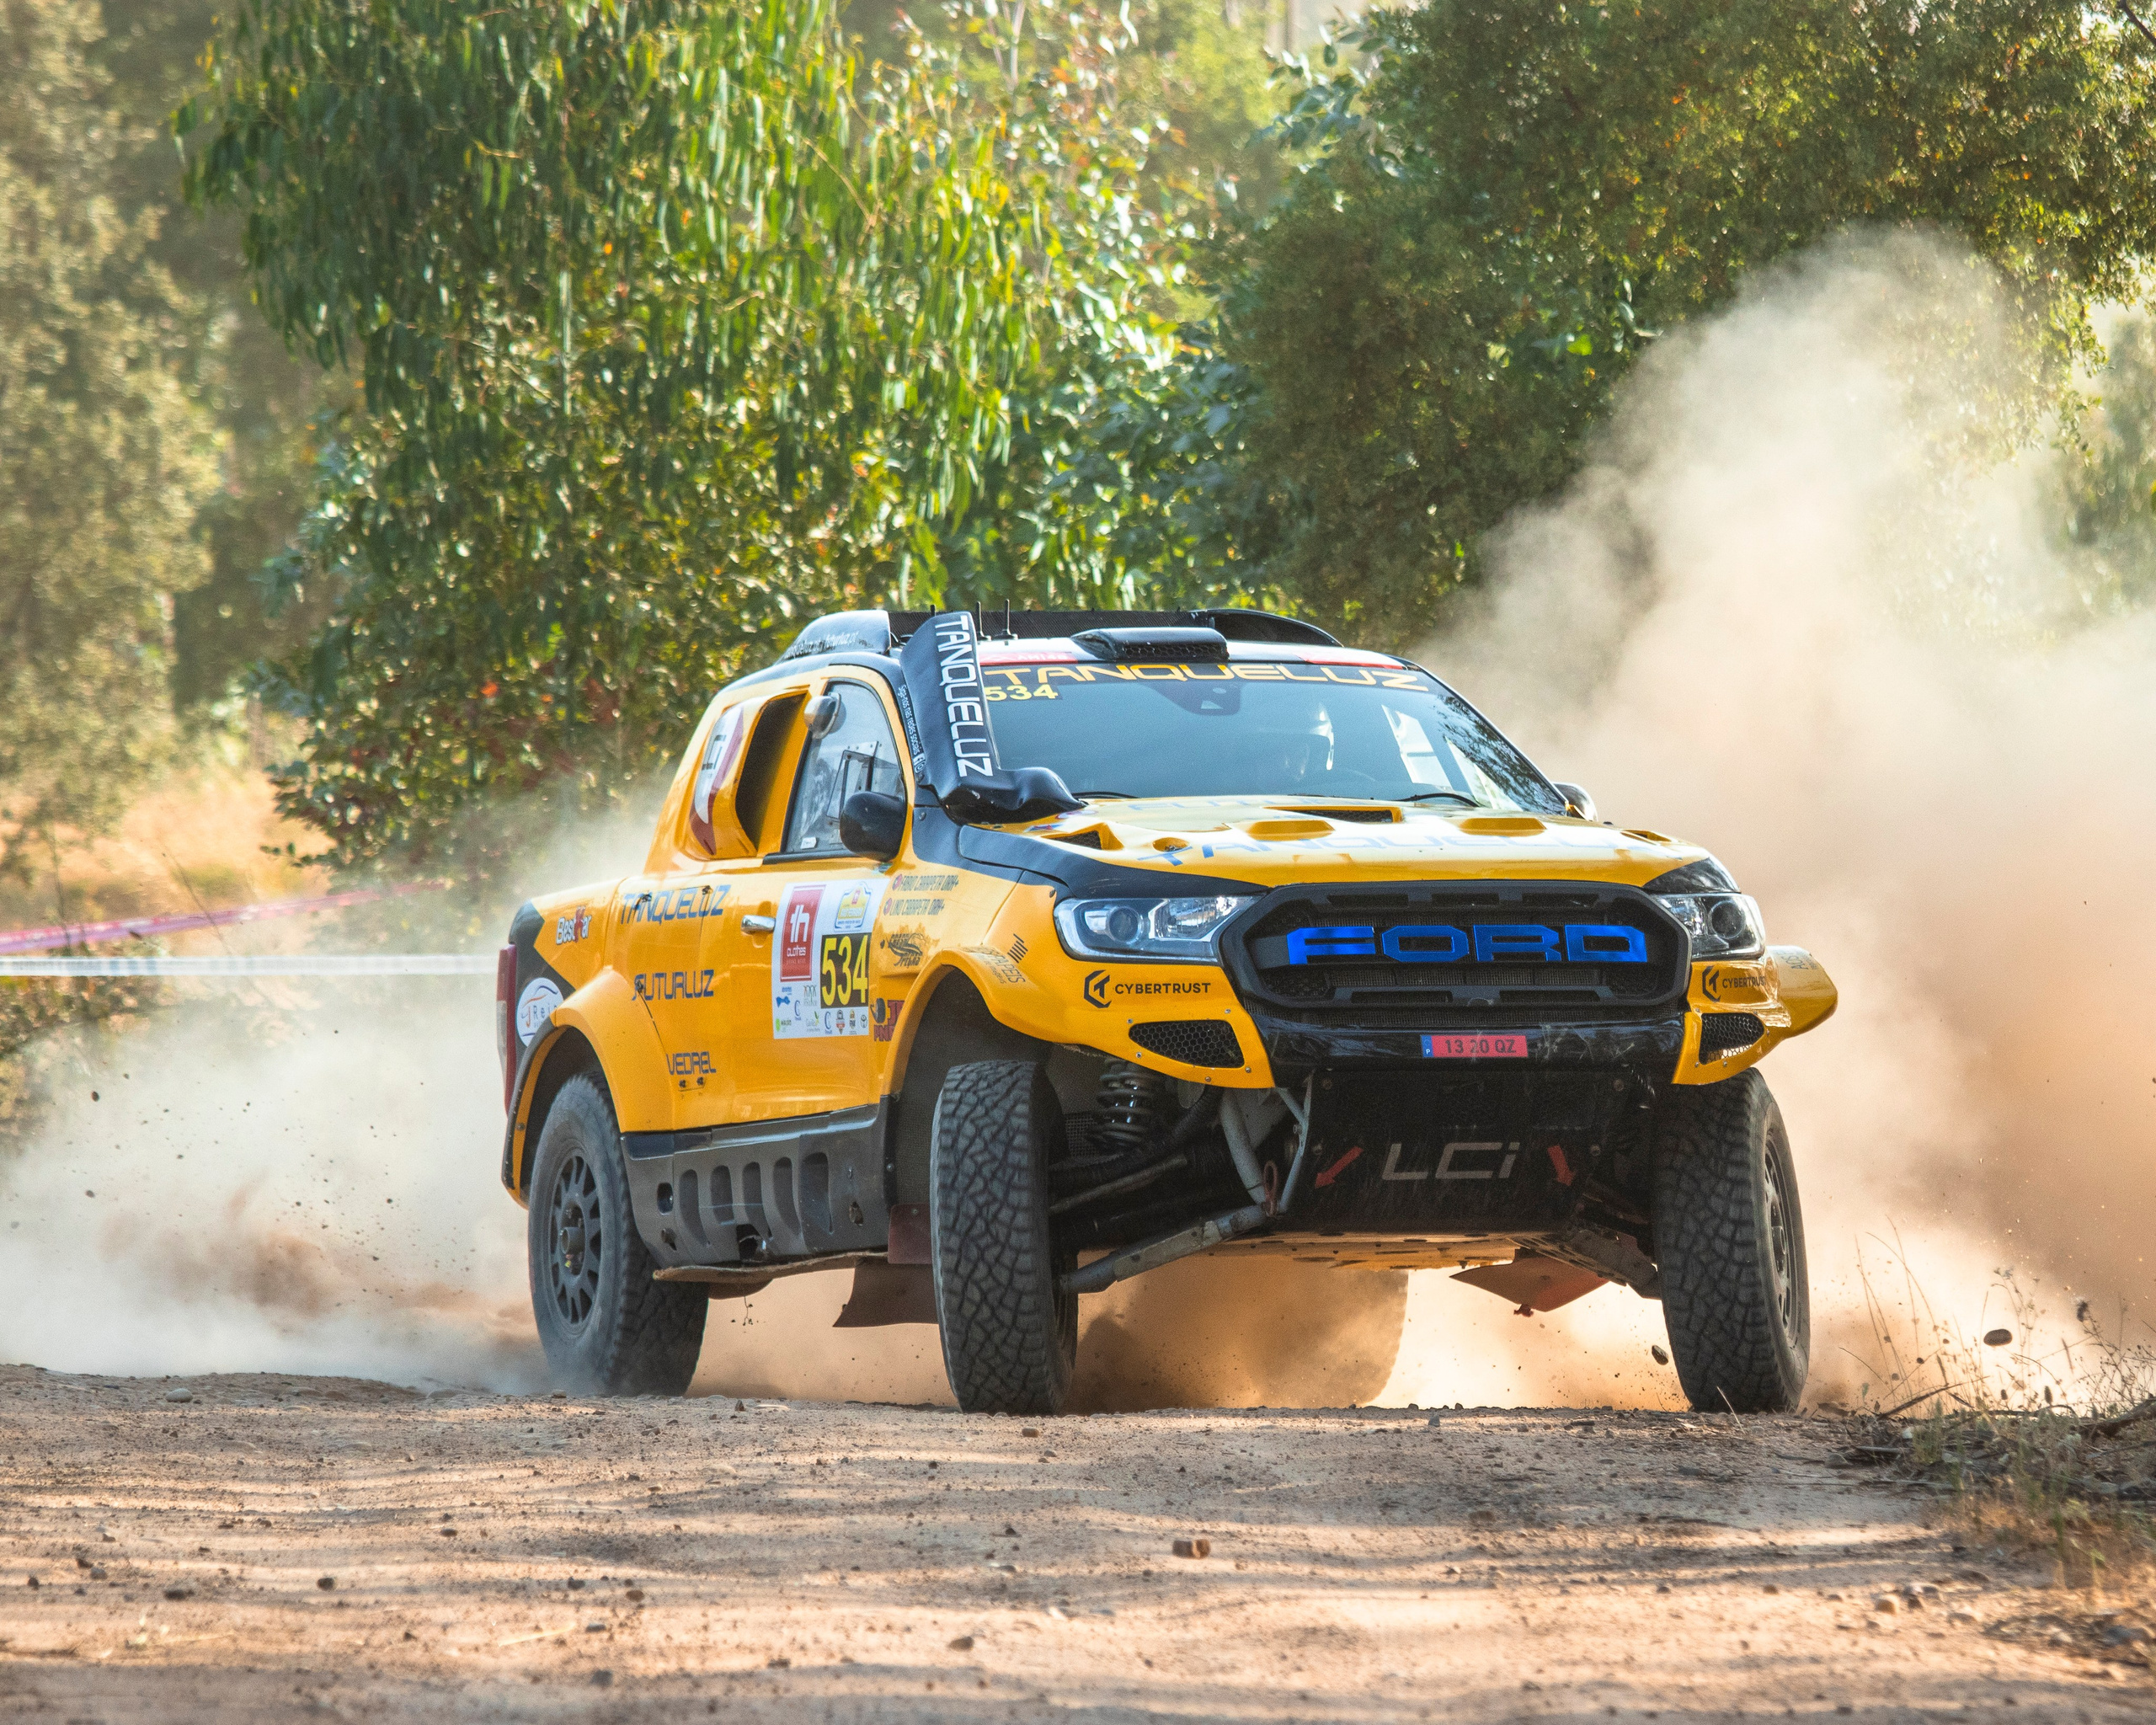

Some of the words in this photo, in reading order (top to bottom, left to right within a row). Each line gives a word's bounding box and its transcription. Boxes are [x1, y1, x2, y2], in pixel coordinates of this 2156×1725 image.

[984, 664, 1429, 692] TANQUELUZ
[985, 684, 1059, 701] 534
[935, 615, 993, 777] TANQUELUZ
[621, 884, 731, 926] TANQUELUZ
[1287, 925, 1647, 964] FORD
[822, 935, 868, 1006] 534
[1114, 983, 1211, 994] CYBERTRUST
[1445, 1039, 1464, 1054] 13
[1470, 1039, 1489, 1054] 20
[1495, 1039, 1516, 1054] QZ
